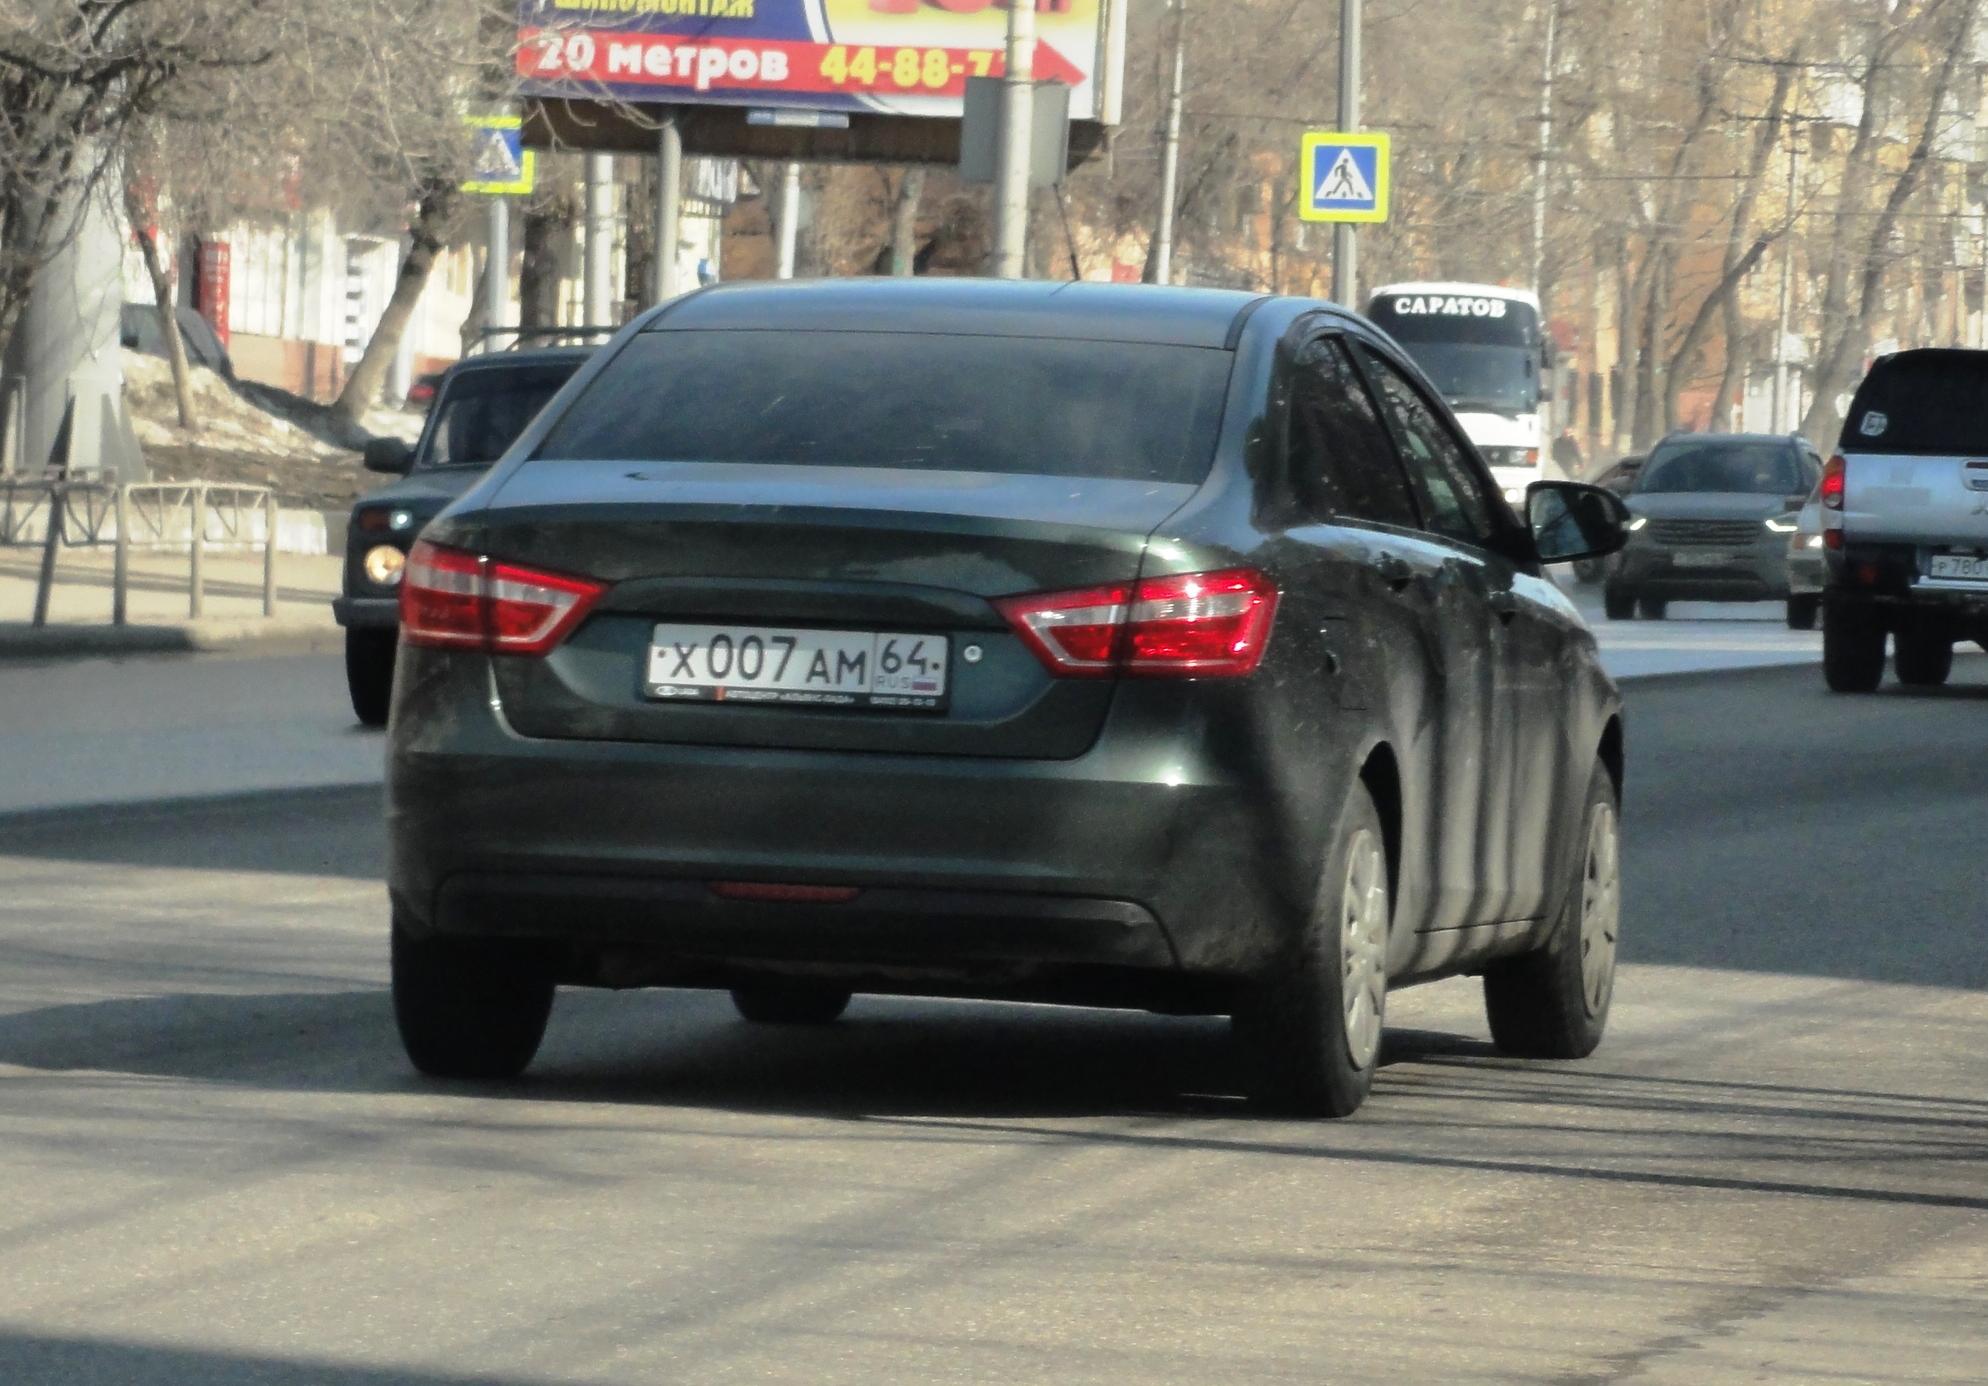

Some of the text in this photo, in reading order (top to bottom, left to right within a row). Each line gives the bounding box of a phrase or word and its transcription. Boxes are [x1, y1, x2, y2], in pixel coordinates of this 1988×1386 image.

[537, 34, 1005, 90] 20 метров 44-88-7
[1395, 296, 1506, 318] САРАТОВ
[880, 639, 928, 675] 64
[876, 675, 911, 689] RUS
